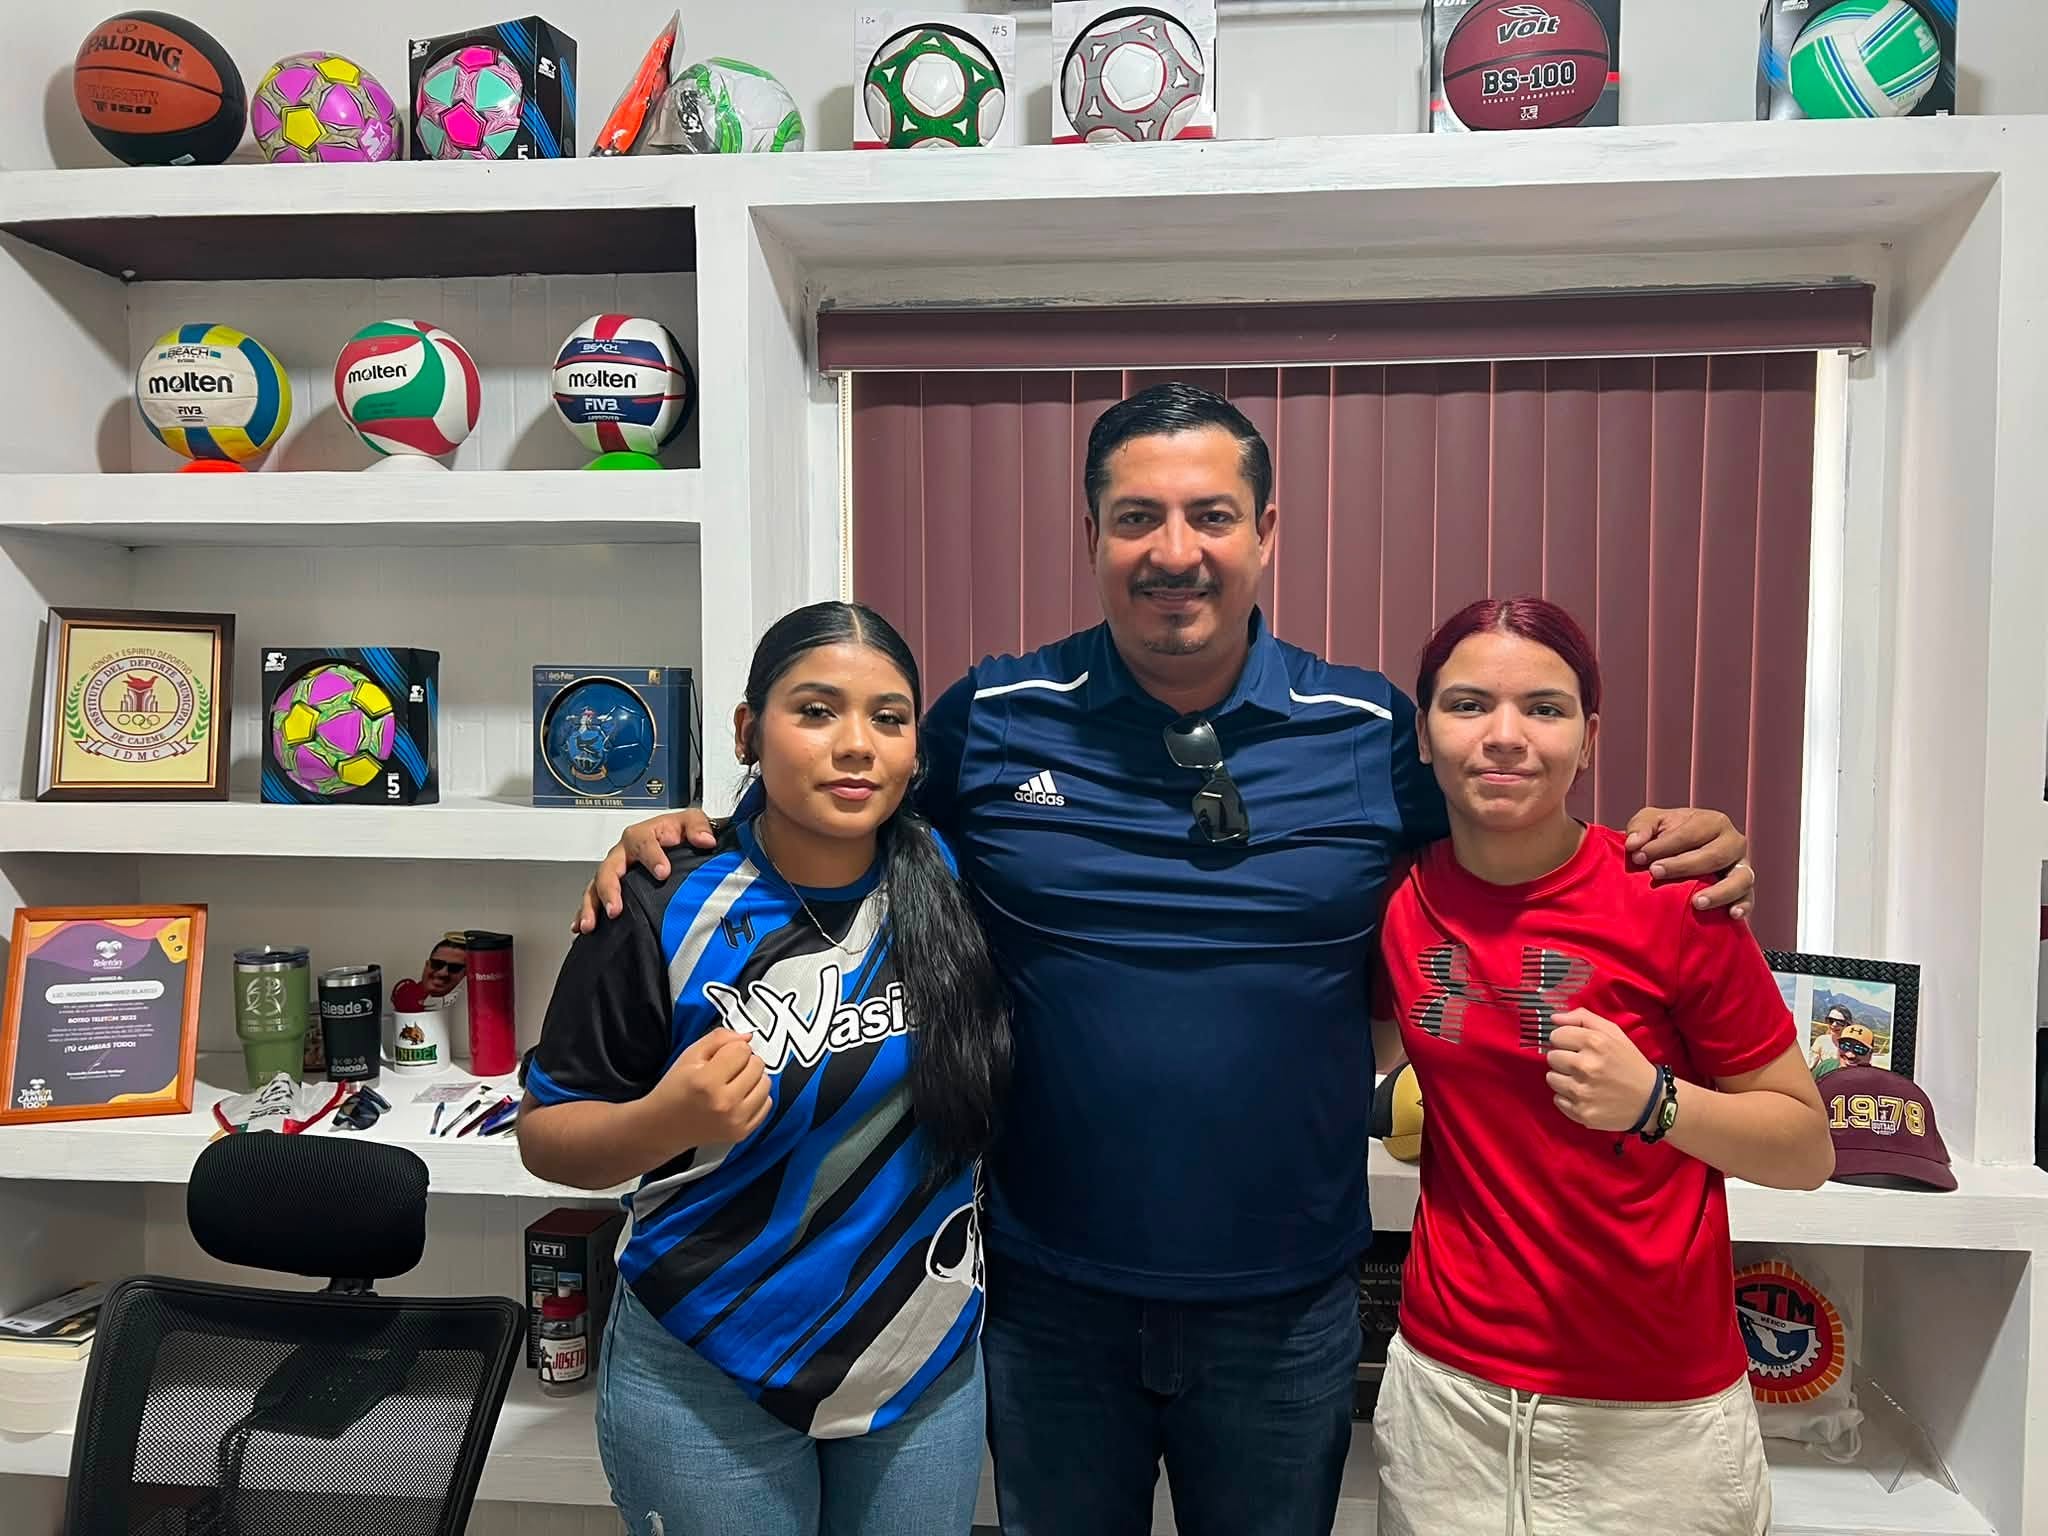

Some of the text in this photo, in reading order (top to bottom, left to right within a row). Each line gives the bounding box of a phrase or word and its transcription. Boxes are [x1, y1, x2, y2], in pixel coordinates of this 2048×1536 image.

[991, 25, 1008, 37] #5
[1497, 16, 1560, 44] Voit
[1482, 60, 1576, 96] BS-100
[167, 346, 209, 357] BEACH
[582, 342, 618, 351] BEACH
[149, 371, 234, 394] molten
[348, 364, 408, 384] molten
[569, 370, 637, 389] molten
[178, 405, 203, 415] FIVB
[584, 397, 620, 411] FIVB
[87, 659, 192, 727] INSTITUTO DEL DEPORTE MUNICIPAL
[111, 731, 167, 746] DE CAJEME
[386, 774, 400, 795] 5
[1014, 789, 1065, 806] adidas
[1829, 1094, 1926, 1137] 1978
[532, 1243, 564, 1257] YETI
